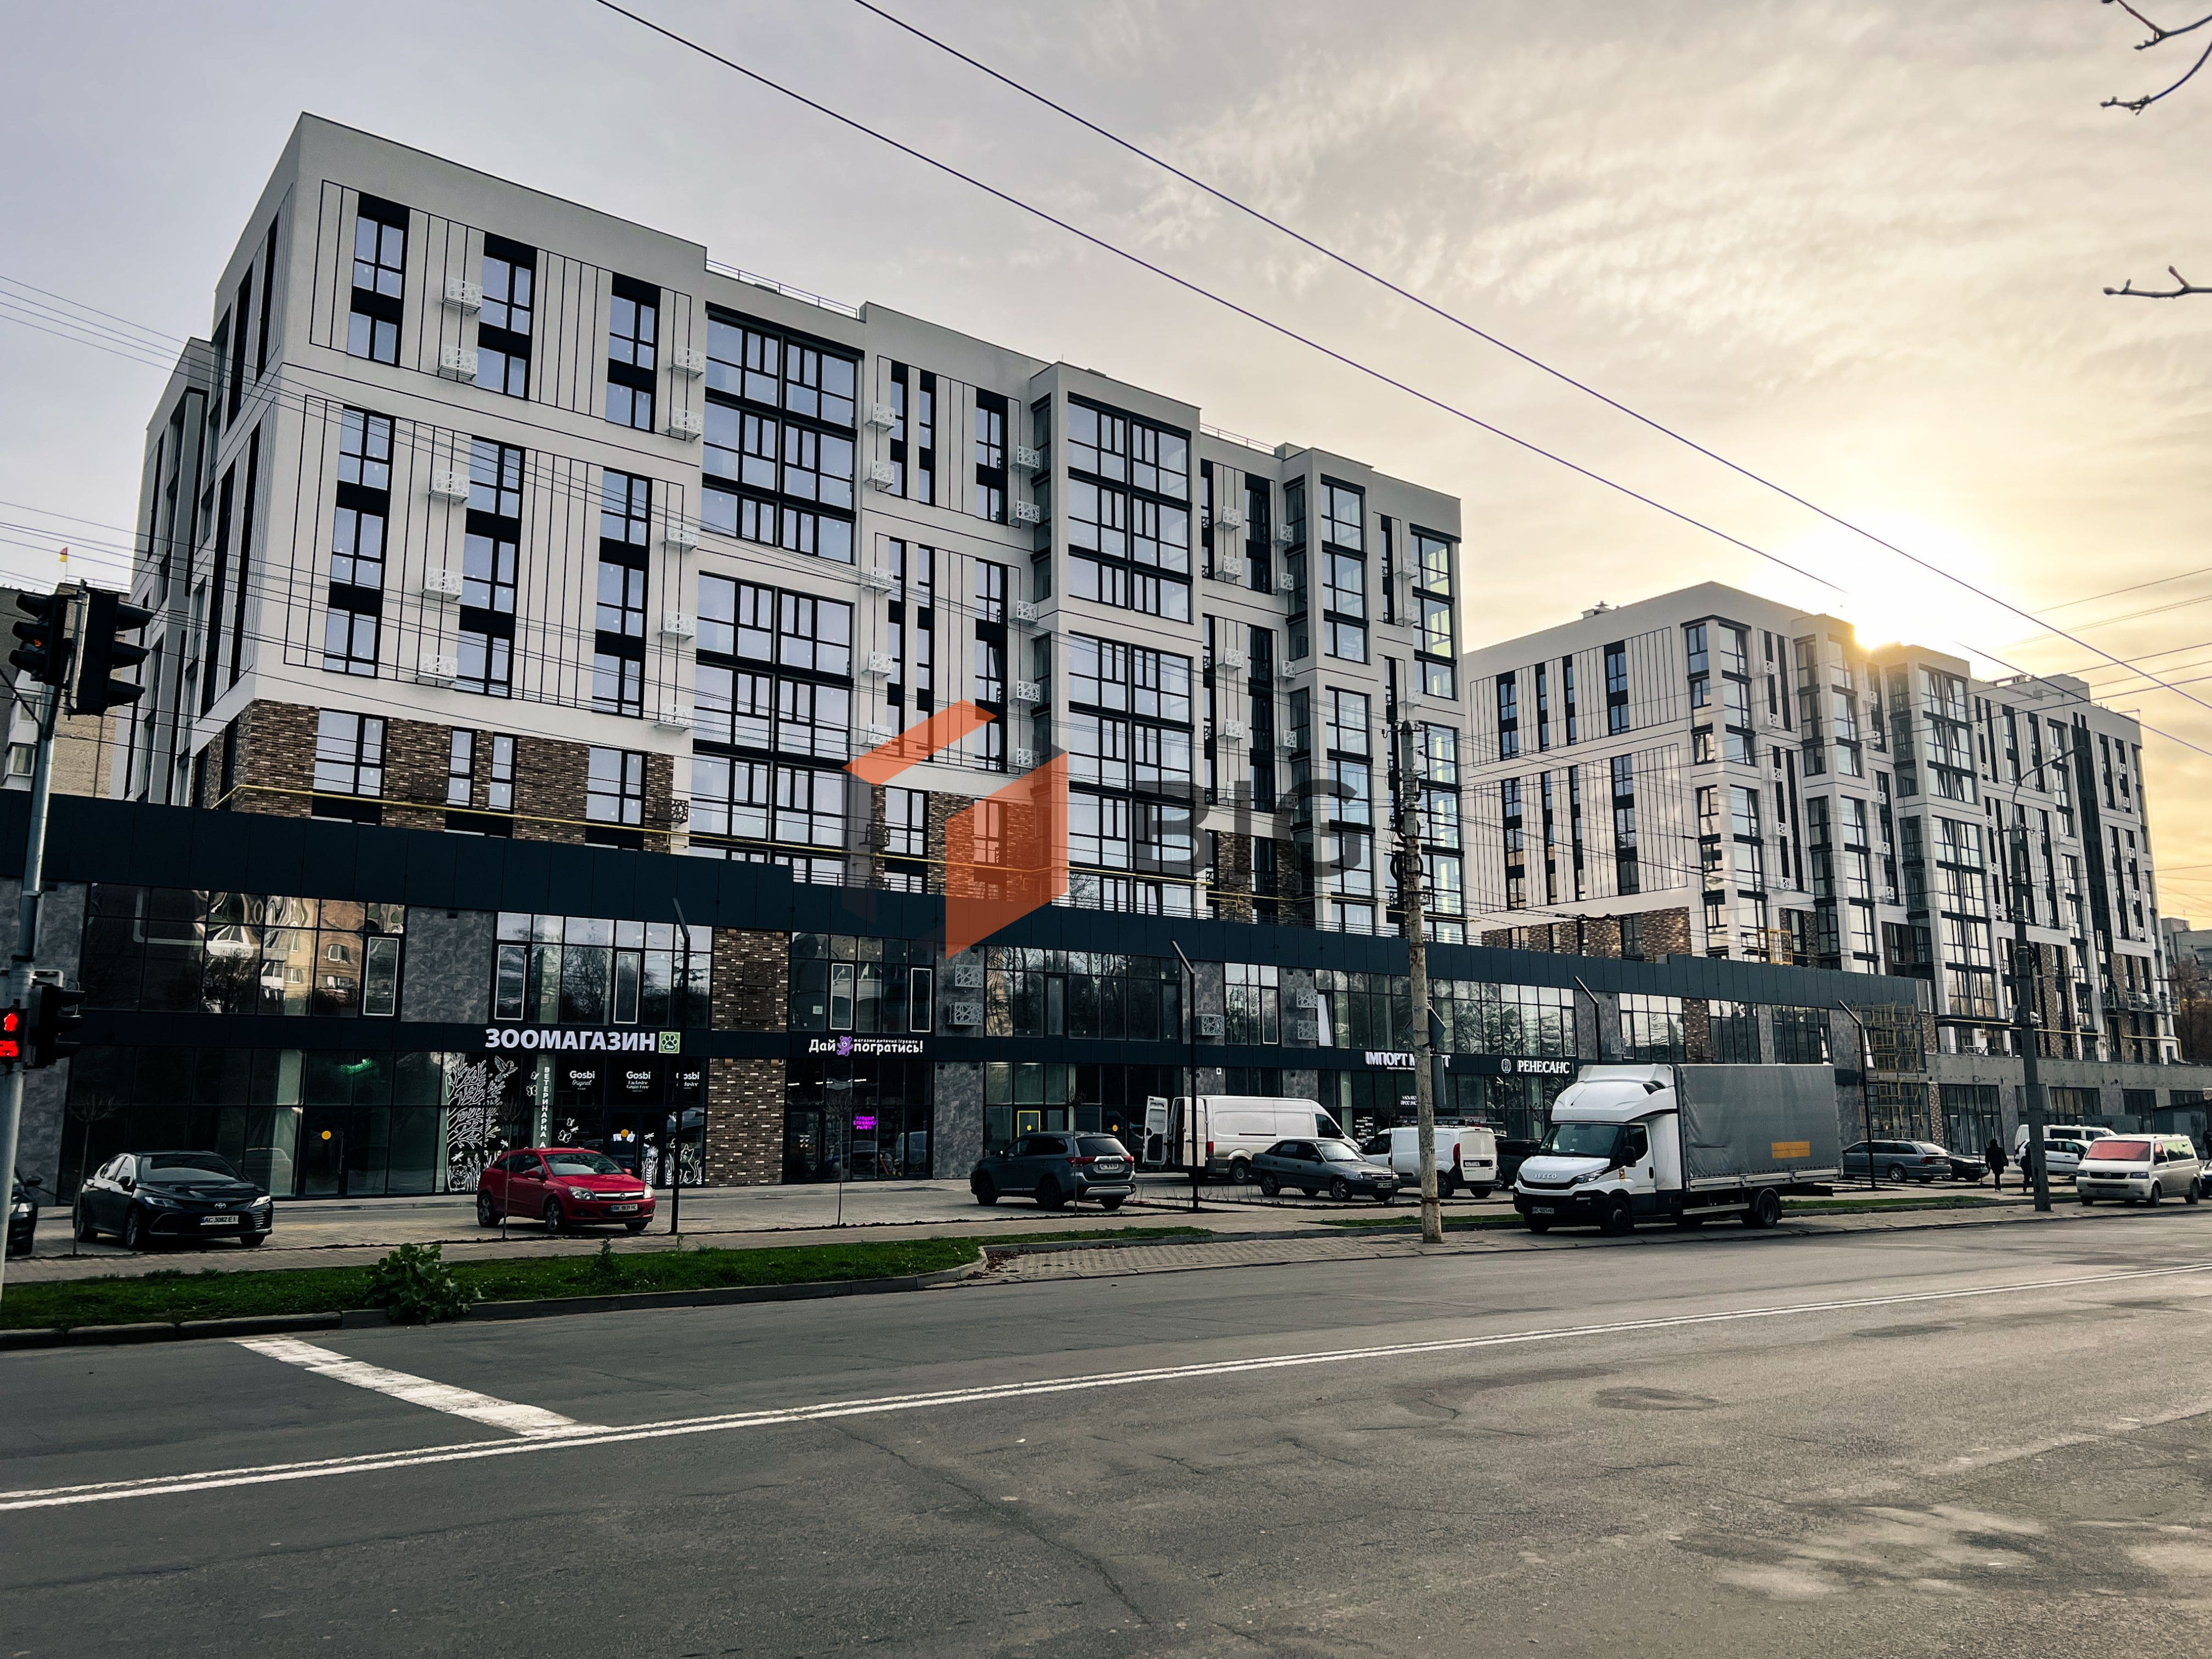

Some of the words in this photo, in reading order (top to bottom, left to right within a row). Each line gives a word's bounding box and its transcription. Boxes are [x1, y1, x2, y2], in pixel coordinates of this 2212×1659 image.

[485, 1029, 655, 1051] ЗООМАГАЗИН
[809, 1039, 836, 1053] Дай
[854, 1040, 923, 1056] погратись!
[569, 1070, 595, 1079] Gosbi
[1517, 1060, 1570, 1074] РЕНЕСАНС
[626, 1071, 651, 1079] Gosbi
[540, 1066, 550, 1138] ВЕТЕРИНАРНА
